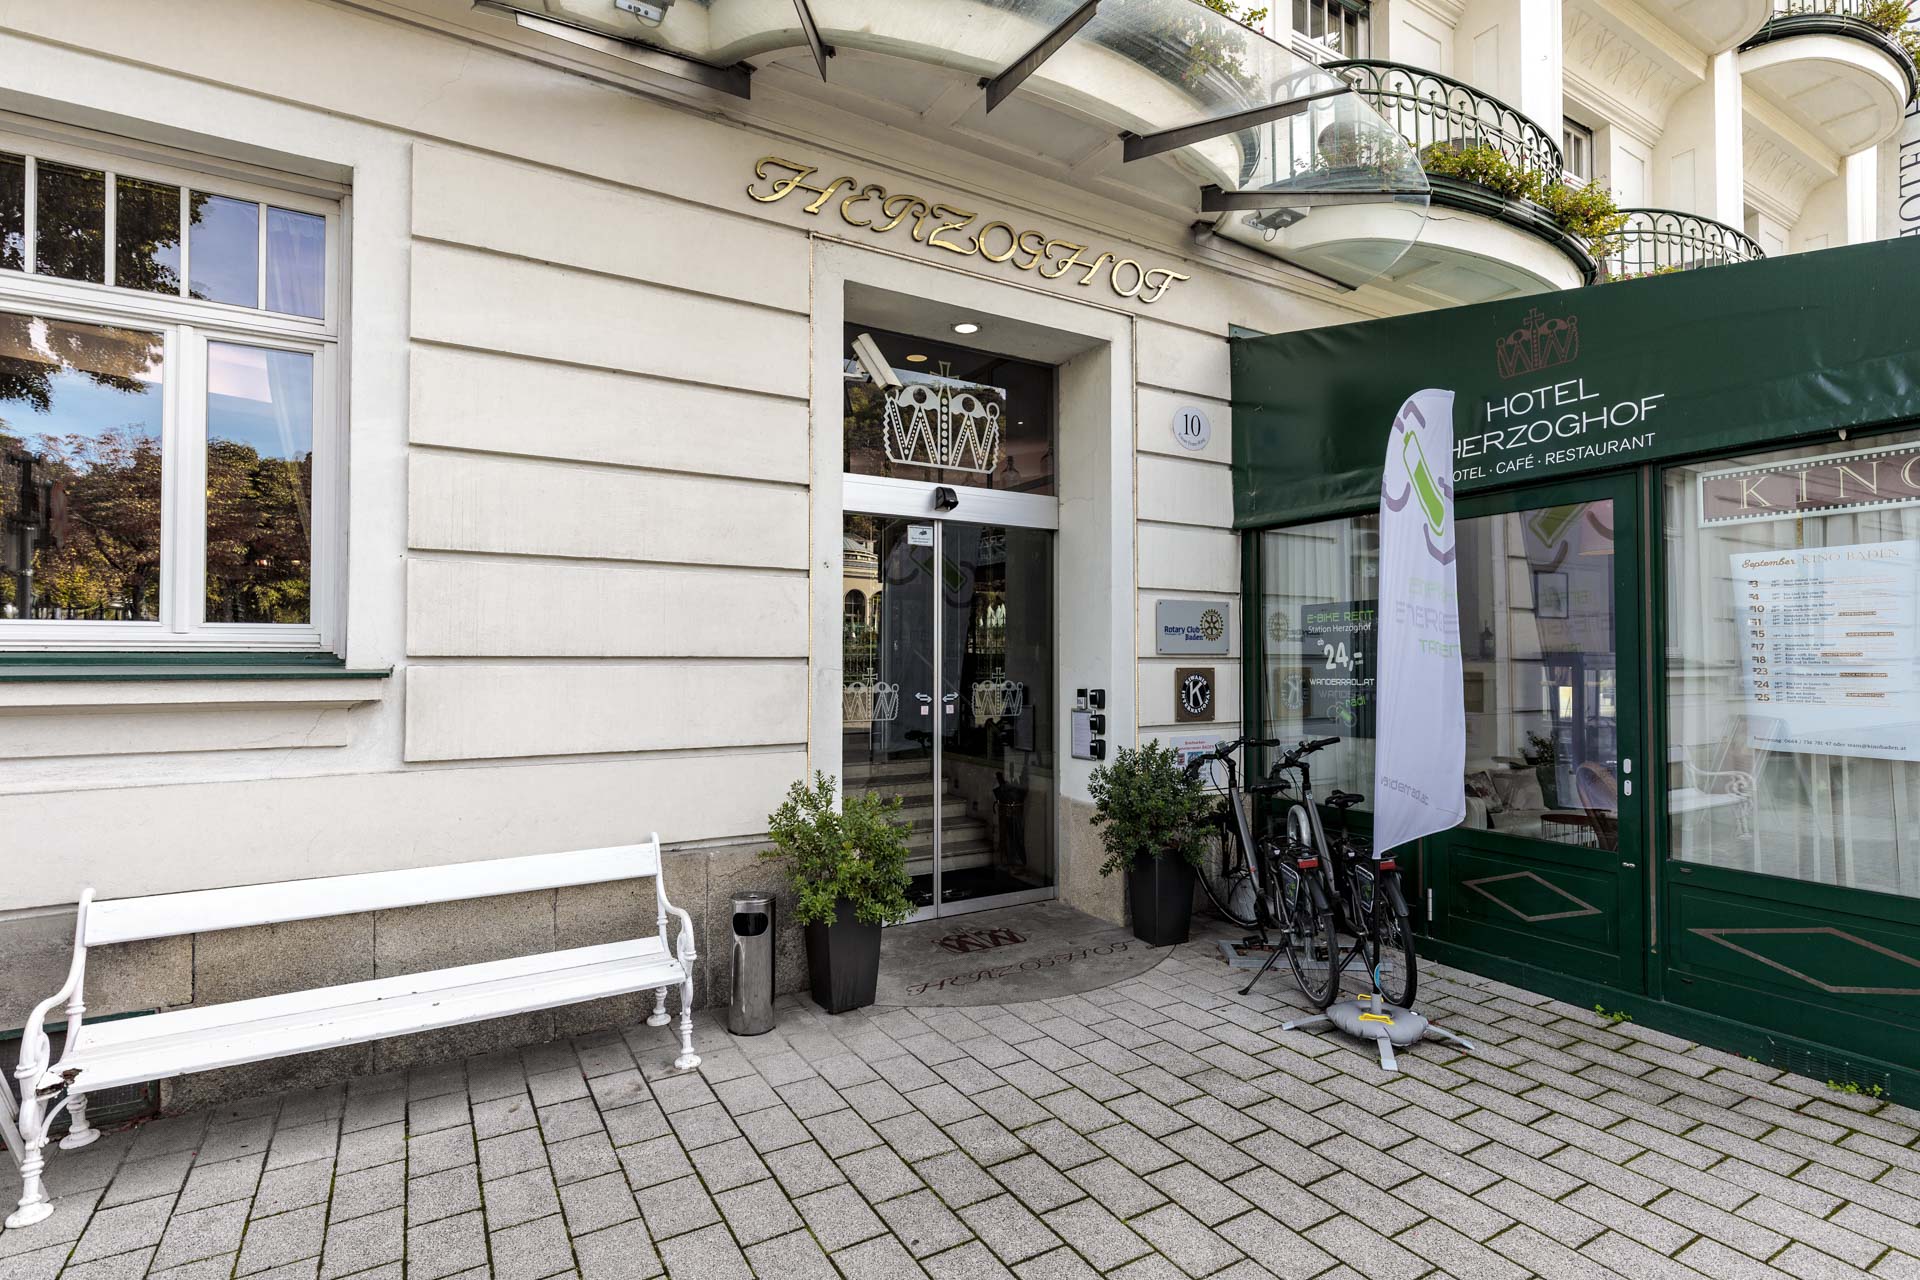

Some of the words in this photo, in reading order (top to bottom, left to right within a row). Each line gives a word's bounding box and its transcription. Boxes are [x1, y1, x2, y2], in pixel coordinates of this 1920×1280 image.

[747, 155, 1190, 304] HERZOGHOF
[1487, 378, 1599, 421] HOTEL
[1184, 414, 1201, 437] 10
[1452, 466, 1486, 483] OTEL
[1496, 454, 1535, 475] CAFÉ
[1545, 432, 1656, 466] RESTAURANT
[1742, 557, 1796, 569] September
[1802, 551, 1841, 564] KINO
[1846, 549, 1900, 561] BADEN
[1306, 612, 1341, 624] E-BIKE
[1343, 609, 1375, 621] RENT
[1164, 625, 1185, 634] Rotary
[1186, 626, 1201, 634] Club
[1308, 625, 1332, 633] Station
[1332, 622, 1372, 633] Herzoghof
[1185, 633, 1205, 641] Baden
[1184, 674, 1208, 687] KIWANIS
[1309, 677, 1375, 686] WANDERRADL.AT
[1181, 690, 1211, 714] INTERNATIONAL
